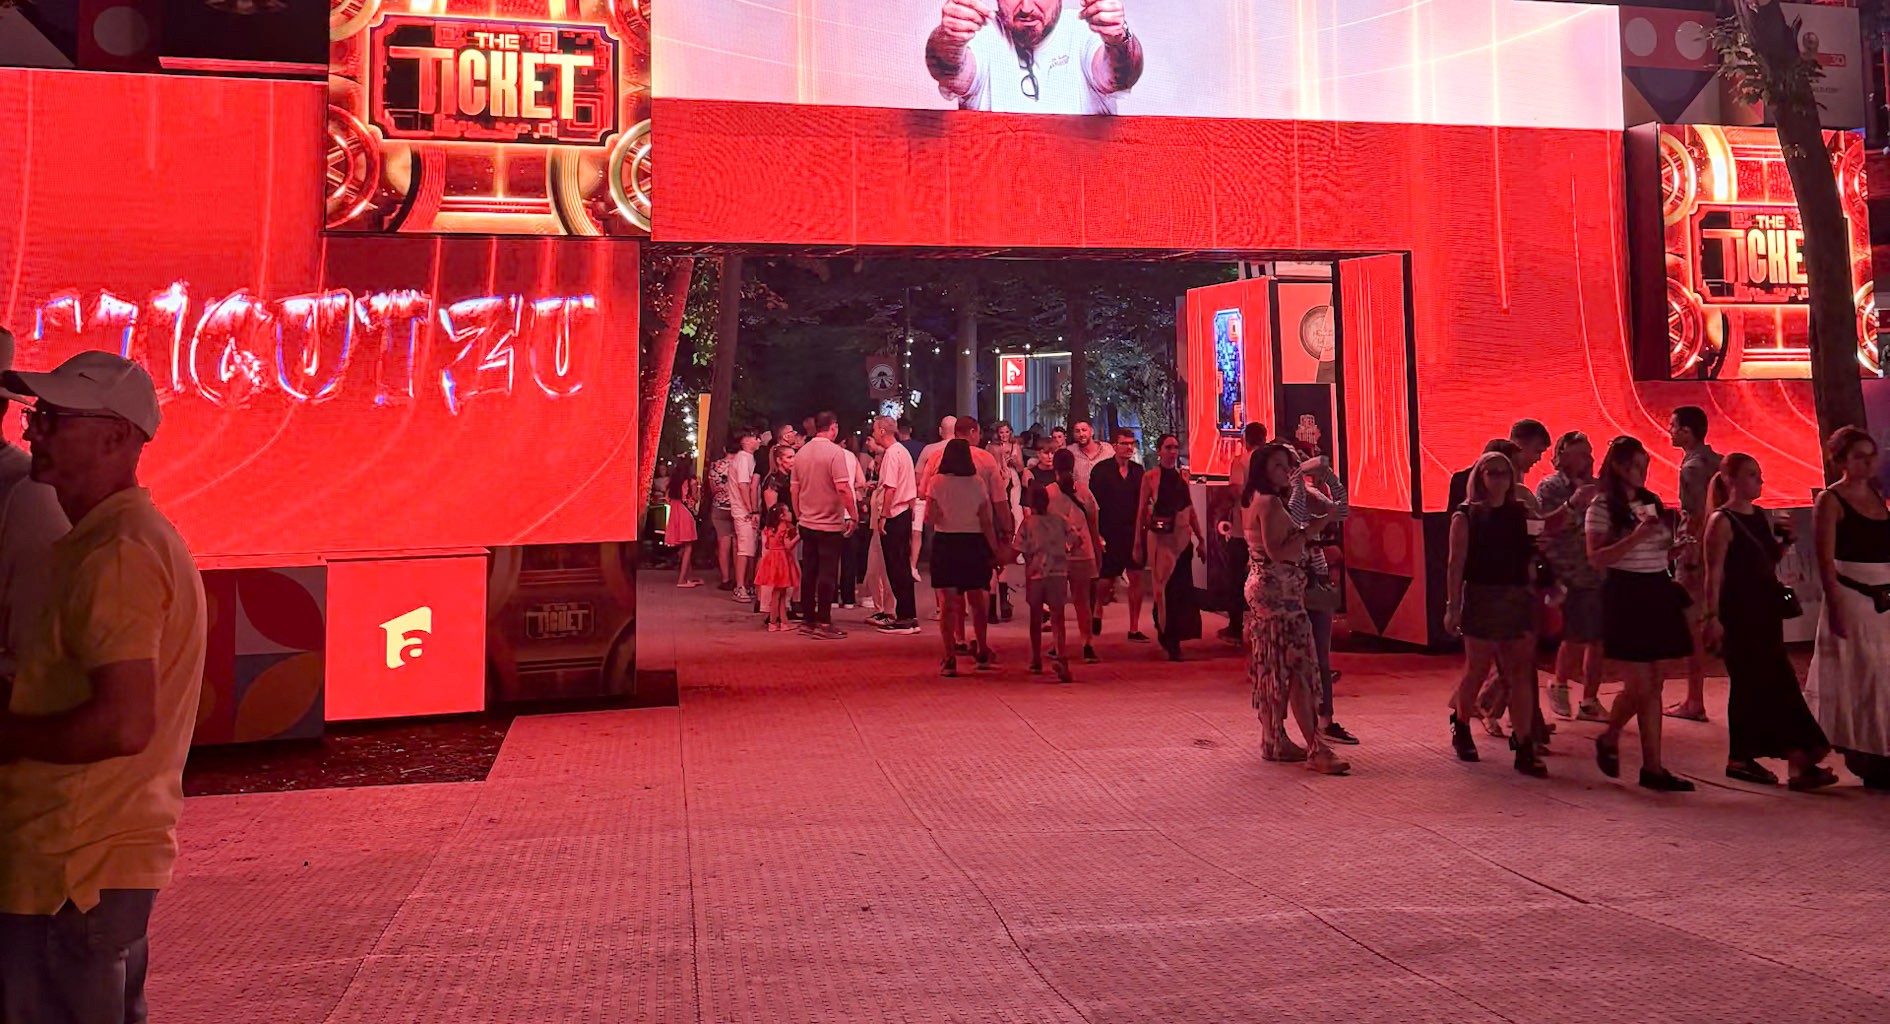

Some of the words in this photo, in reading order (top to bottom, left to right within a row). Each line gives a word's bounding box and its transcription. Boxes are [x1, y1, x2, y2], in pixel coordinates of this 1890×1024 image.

[473, 32, 520, 50] THE
[389, 46, 594, 120] TICKET
[1755, 215, 1786, 229] THE
[1702, 228, 1809, 284] TICKE
